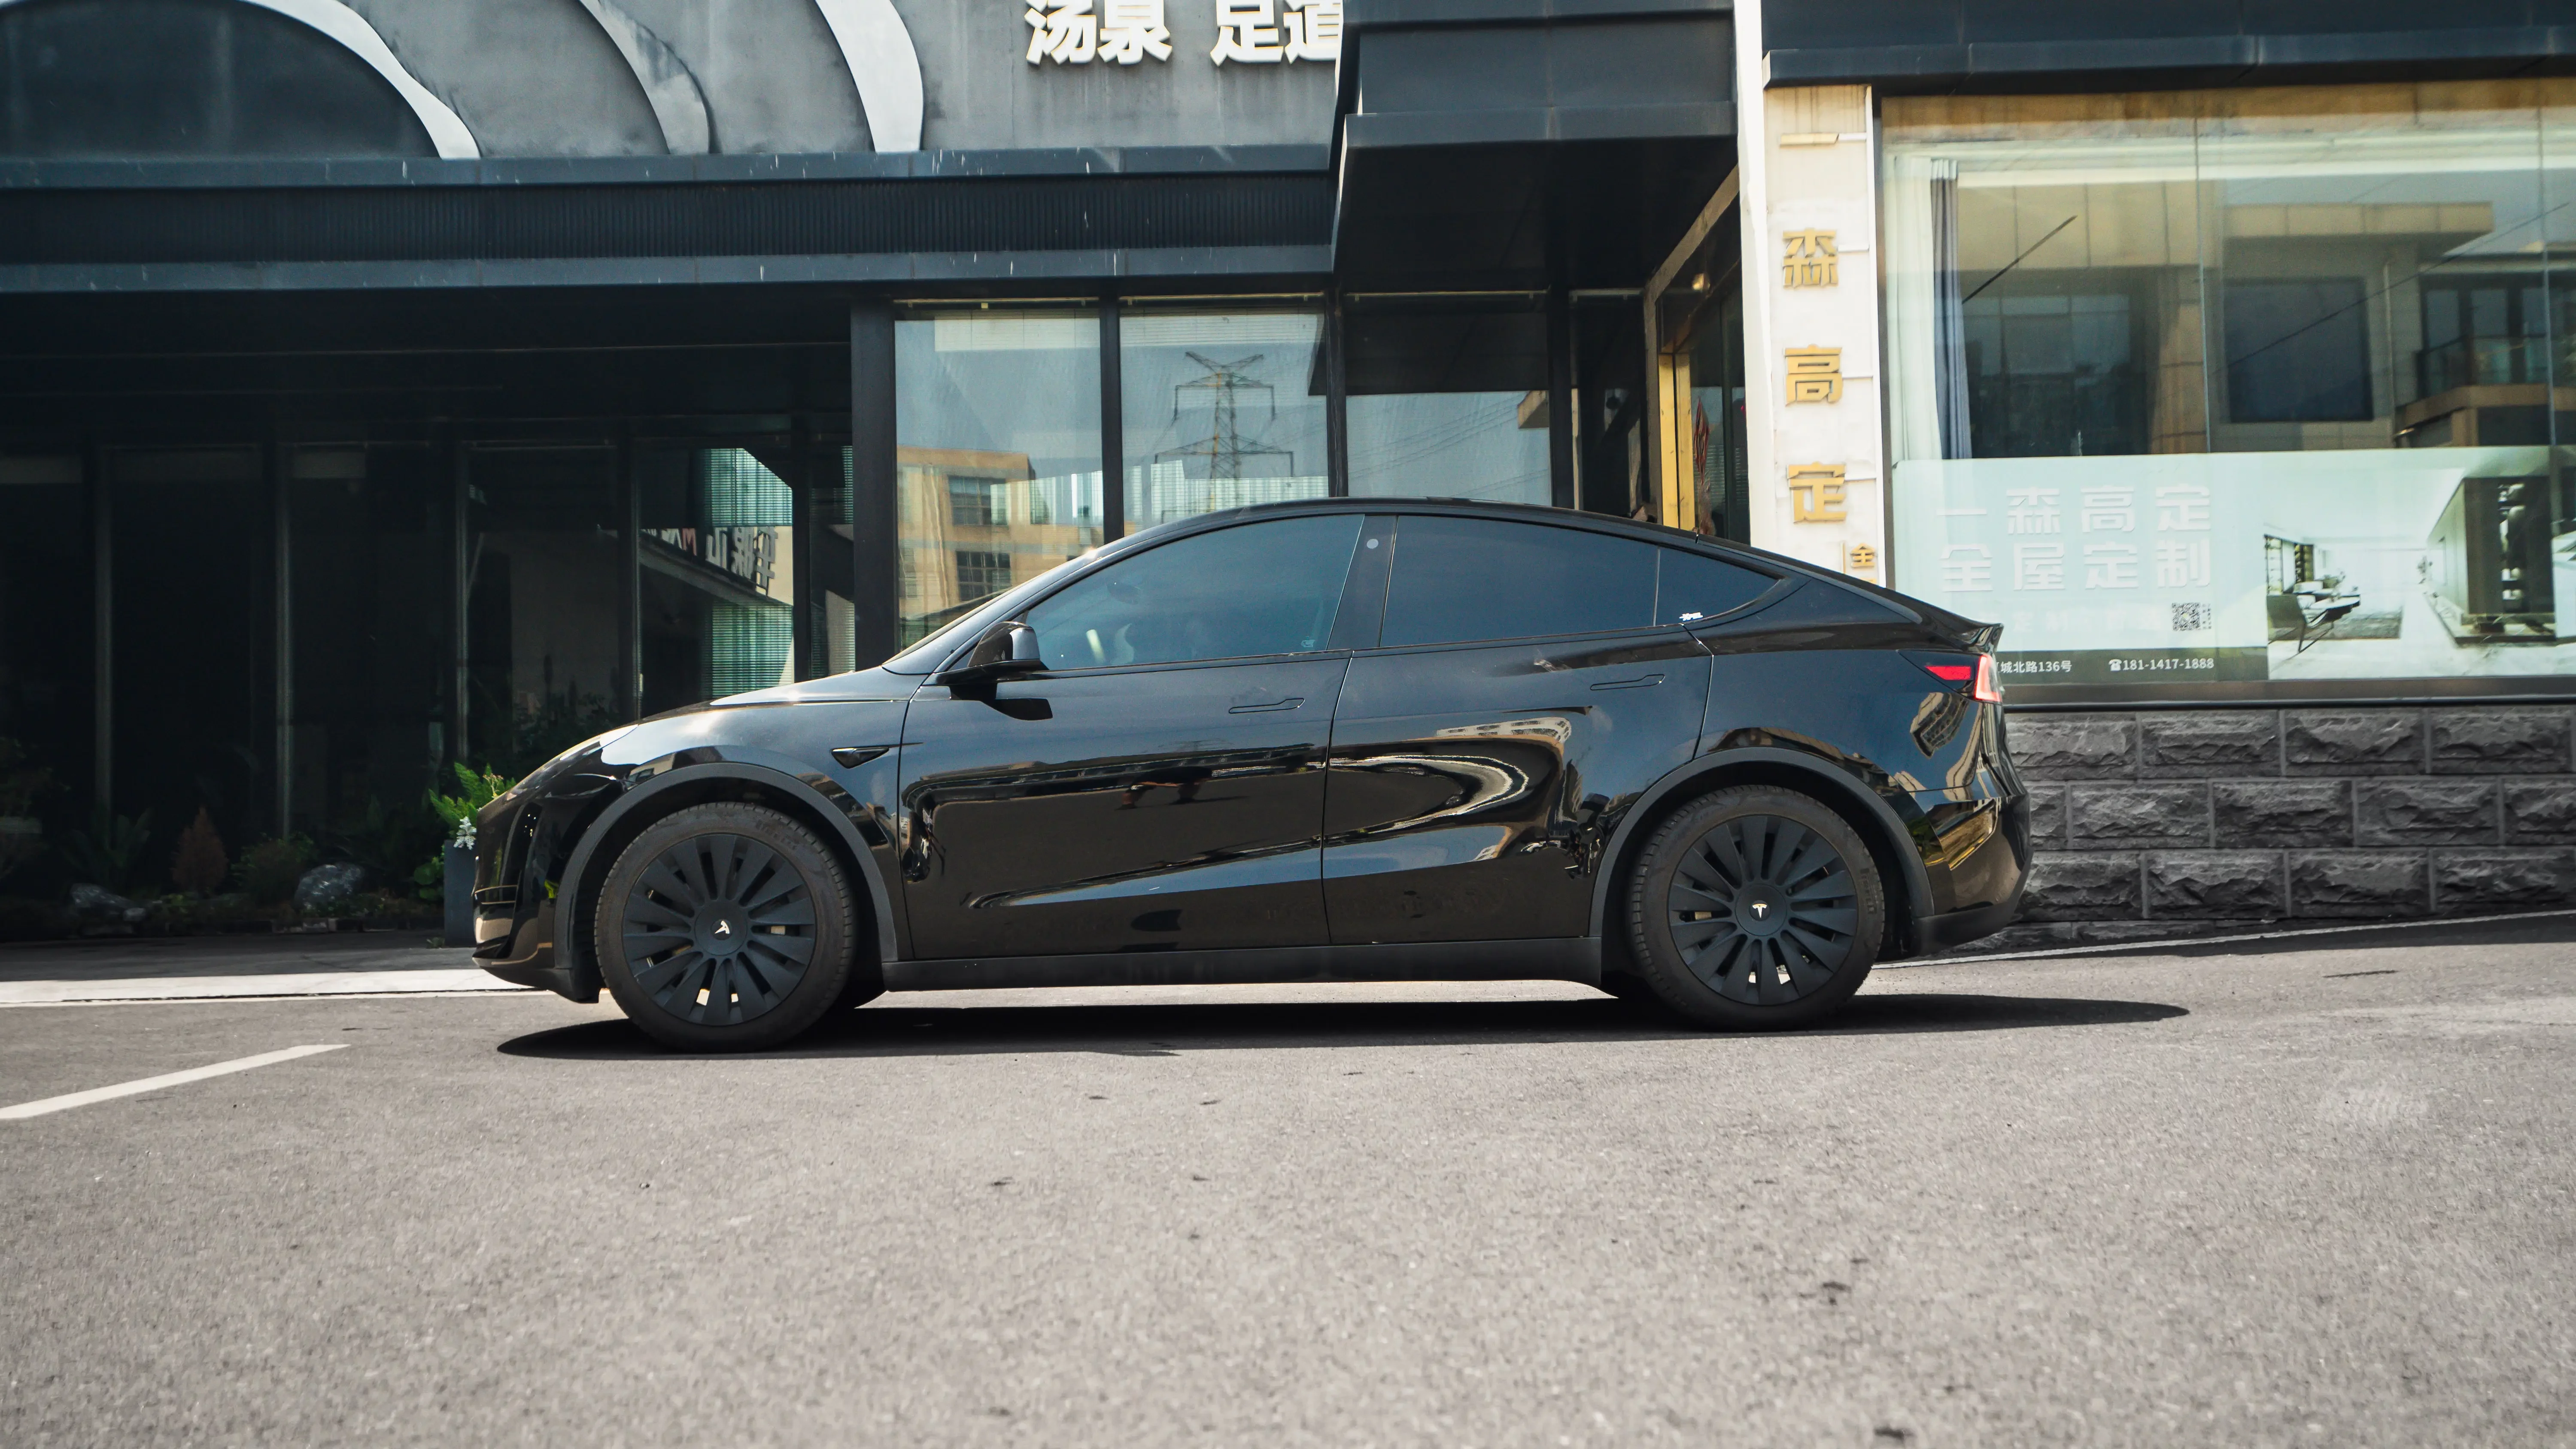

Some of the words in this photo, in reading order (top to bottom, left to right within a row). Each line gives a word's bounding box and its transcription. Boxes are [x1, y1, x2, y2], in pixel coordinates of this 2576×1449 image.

[1024, 0, 1173, 65] 汤泉
[1936, 483, 2212, 535] 一森高定
[1939, 538, 2212, 592] 全屋定制
[1996, 660, 2072, 673] 城北路136号
[2122, 658, 2214, 671] 181-1417-1888
